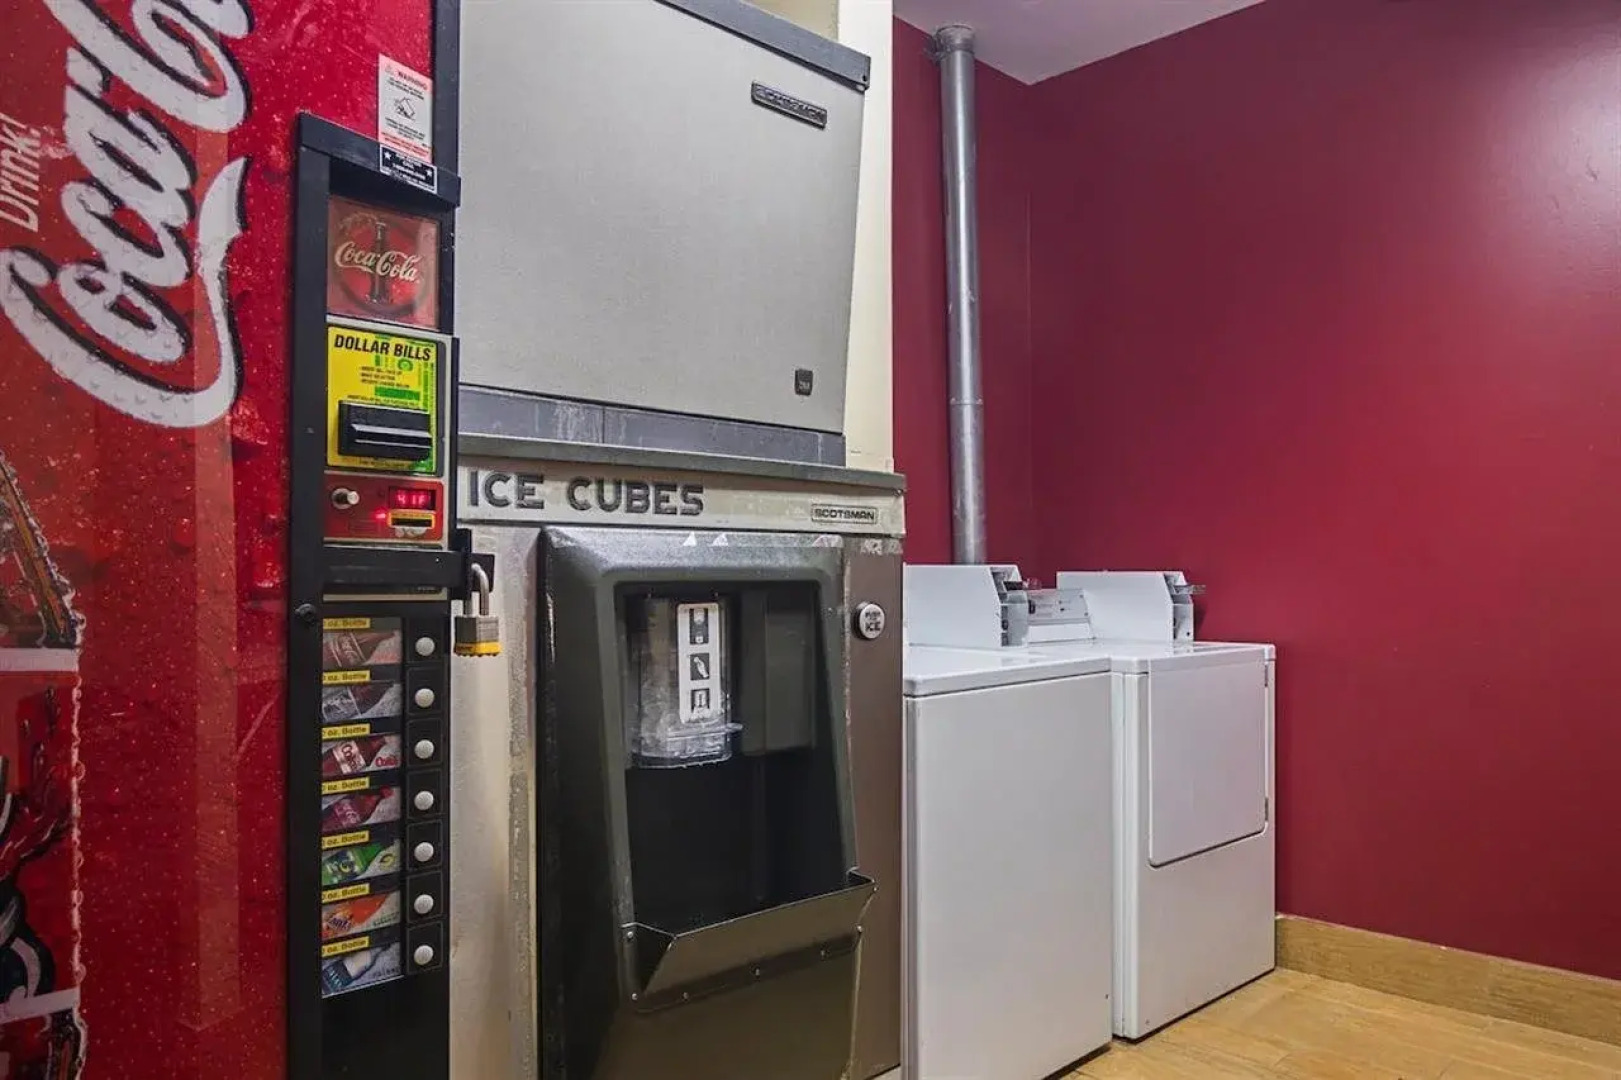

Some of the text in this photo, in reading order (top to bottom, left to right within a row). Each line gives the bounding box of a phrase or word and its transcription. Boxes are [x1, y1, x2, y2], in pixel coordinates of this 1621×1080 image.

[334, 334, 432, 361] DOLLAR BILLS
[470, 471, 704, 516] ICE CUBES
[815, 508, 875, 520] SCOTSMAN
[342, 727, 367, 736] Bottle
